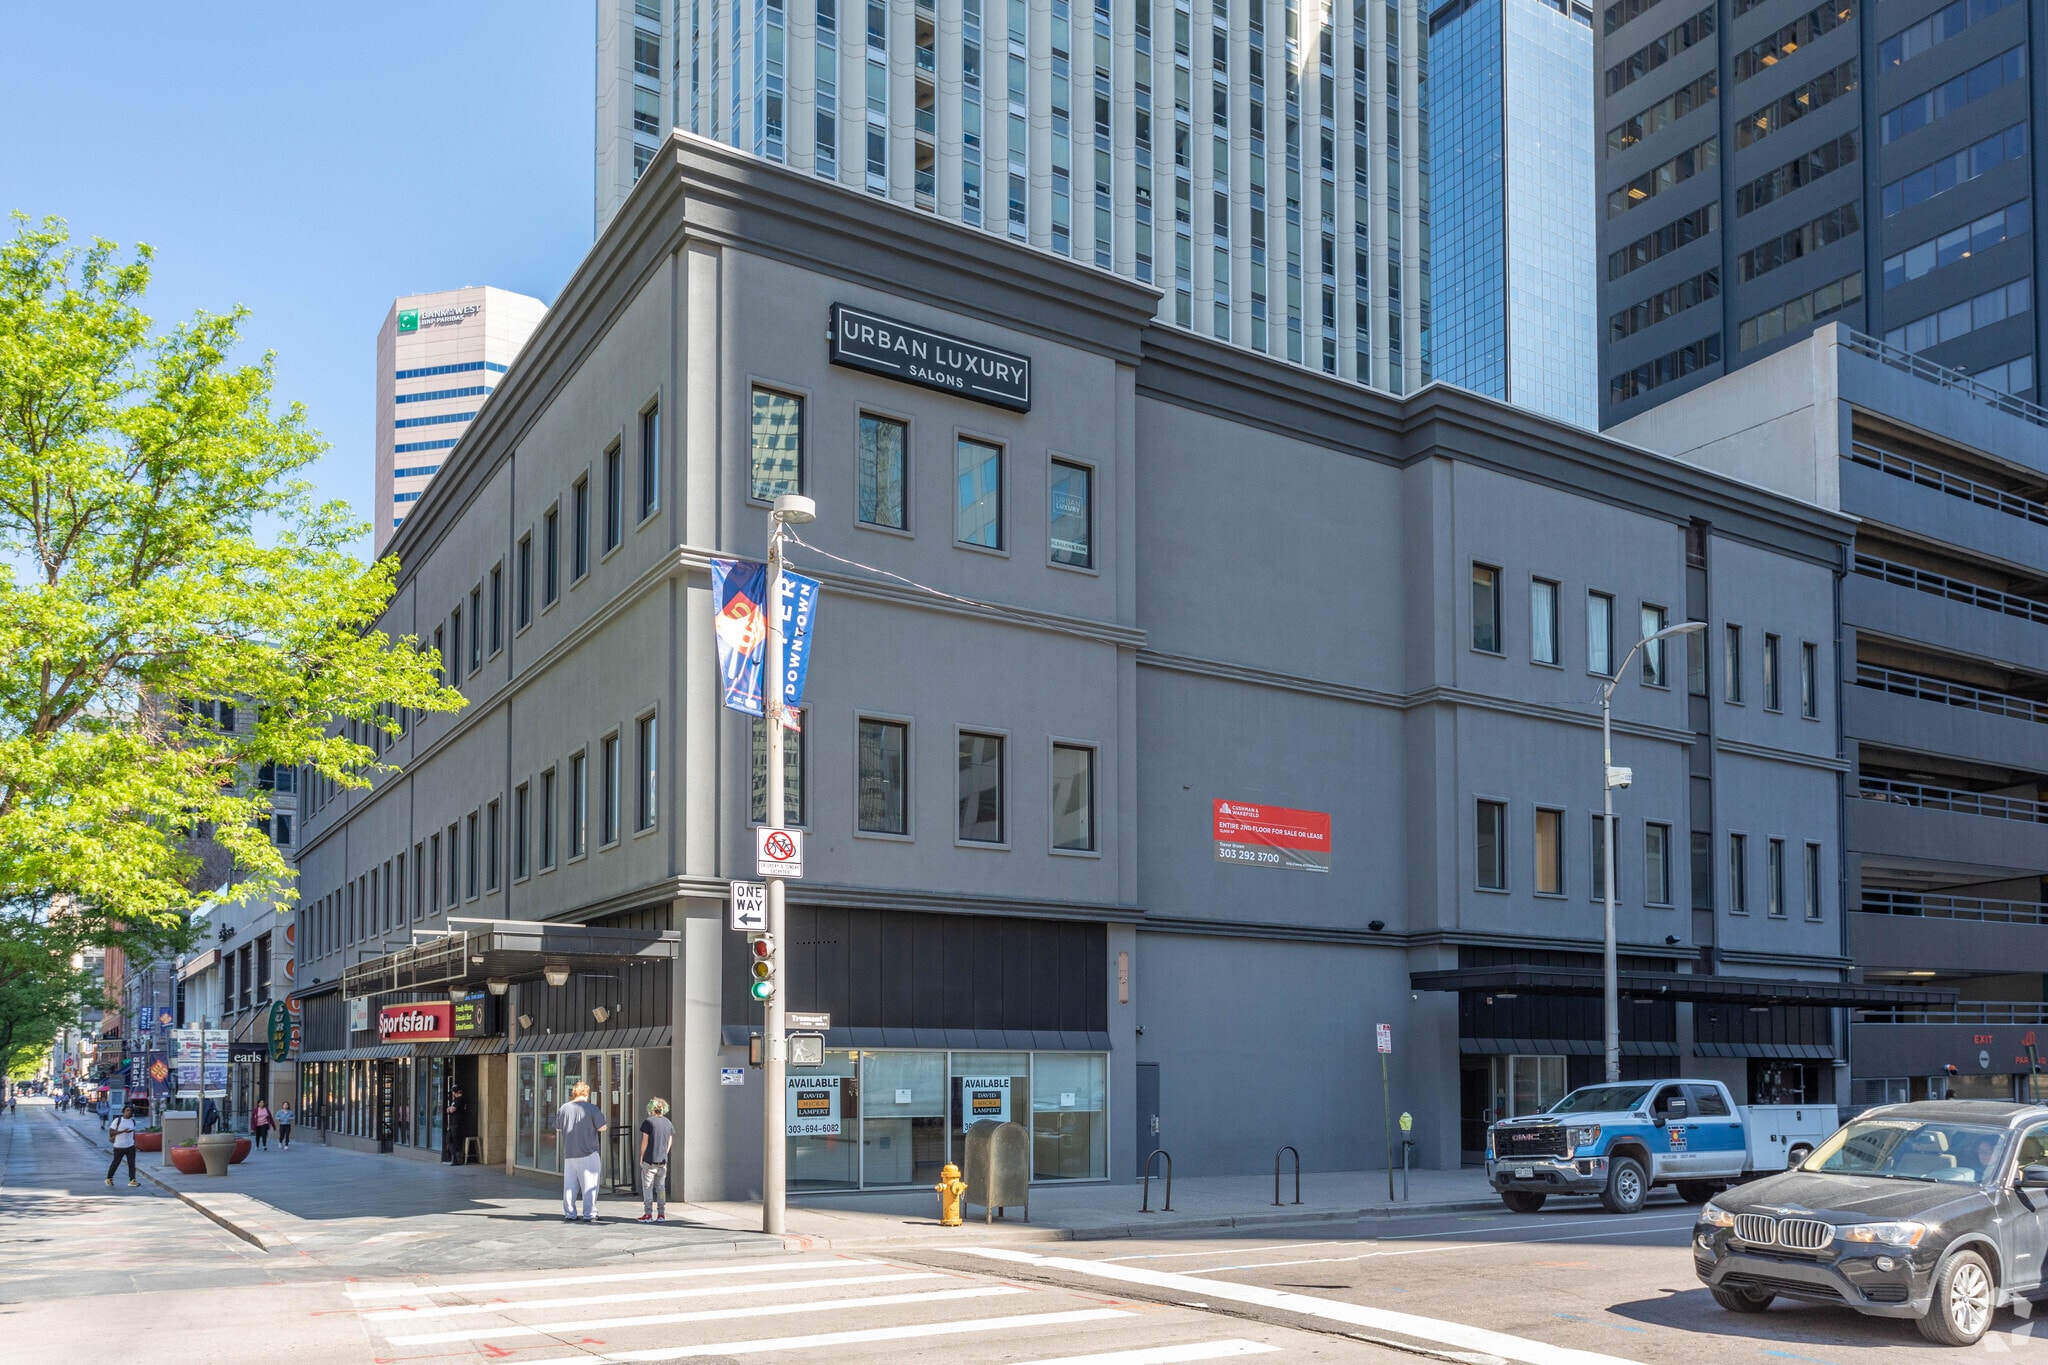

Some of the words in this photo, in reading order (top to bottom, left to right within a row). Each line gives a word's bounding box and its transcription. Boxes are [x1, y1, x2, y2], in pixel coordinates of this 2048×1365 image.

[421, 309, 447, 319] BANK
[454, 304, 481, 314] WEST
[436, 314, 465, 323] PARIBAS
[844, 320, 927, 360] URBAN
[936, 345, 1023, 385] LUXURY
[909, 365, 964, 388] SALONS
[1056, 503, 1081, 514] LUXURY
[785, 583, 811, 696] DOWNTOWN
[1232, 810, 1259, 818] WAKEFIELD
[1219, 821, 1239, 830] ENTIRE
[1252, 825, 1271, 834] FLOOR
[1284, 829, 1297, 837] SALE
[1306, 832, 1323, 840] LEASE
[1219, 848, 1236, 859] 303
[1238, 850, 1255, 861] 292
[1257, 852, 1280, 863] 3700
[737, 886, 762, 898] ONE
[736, 899, 762, 911] WAY
[379, 1010, 435, 1038] Sportsfan
[273, 1003, 286, 1061] SUBWAY
[1973, 1034, 1993, 1044] EXIT
[234, 1051, 262, 1062] earls
[132, 1056, 140, 1087] UPPER
[788, 1078, 839, 1089] AVAILABLE
[965, 1079, 1009, 1089] AVAILABLE
[788, 1123, 839, 1134] 303-694-6082
[1512, 1133, 1540, 1141] GMC
